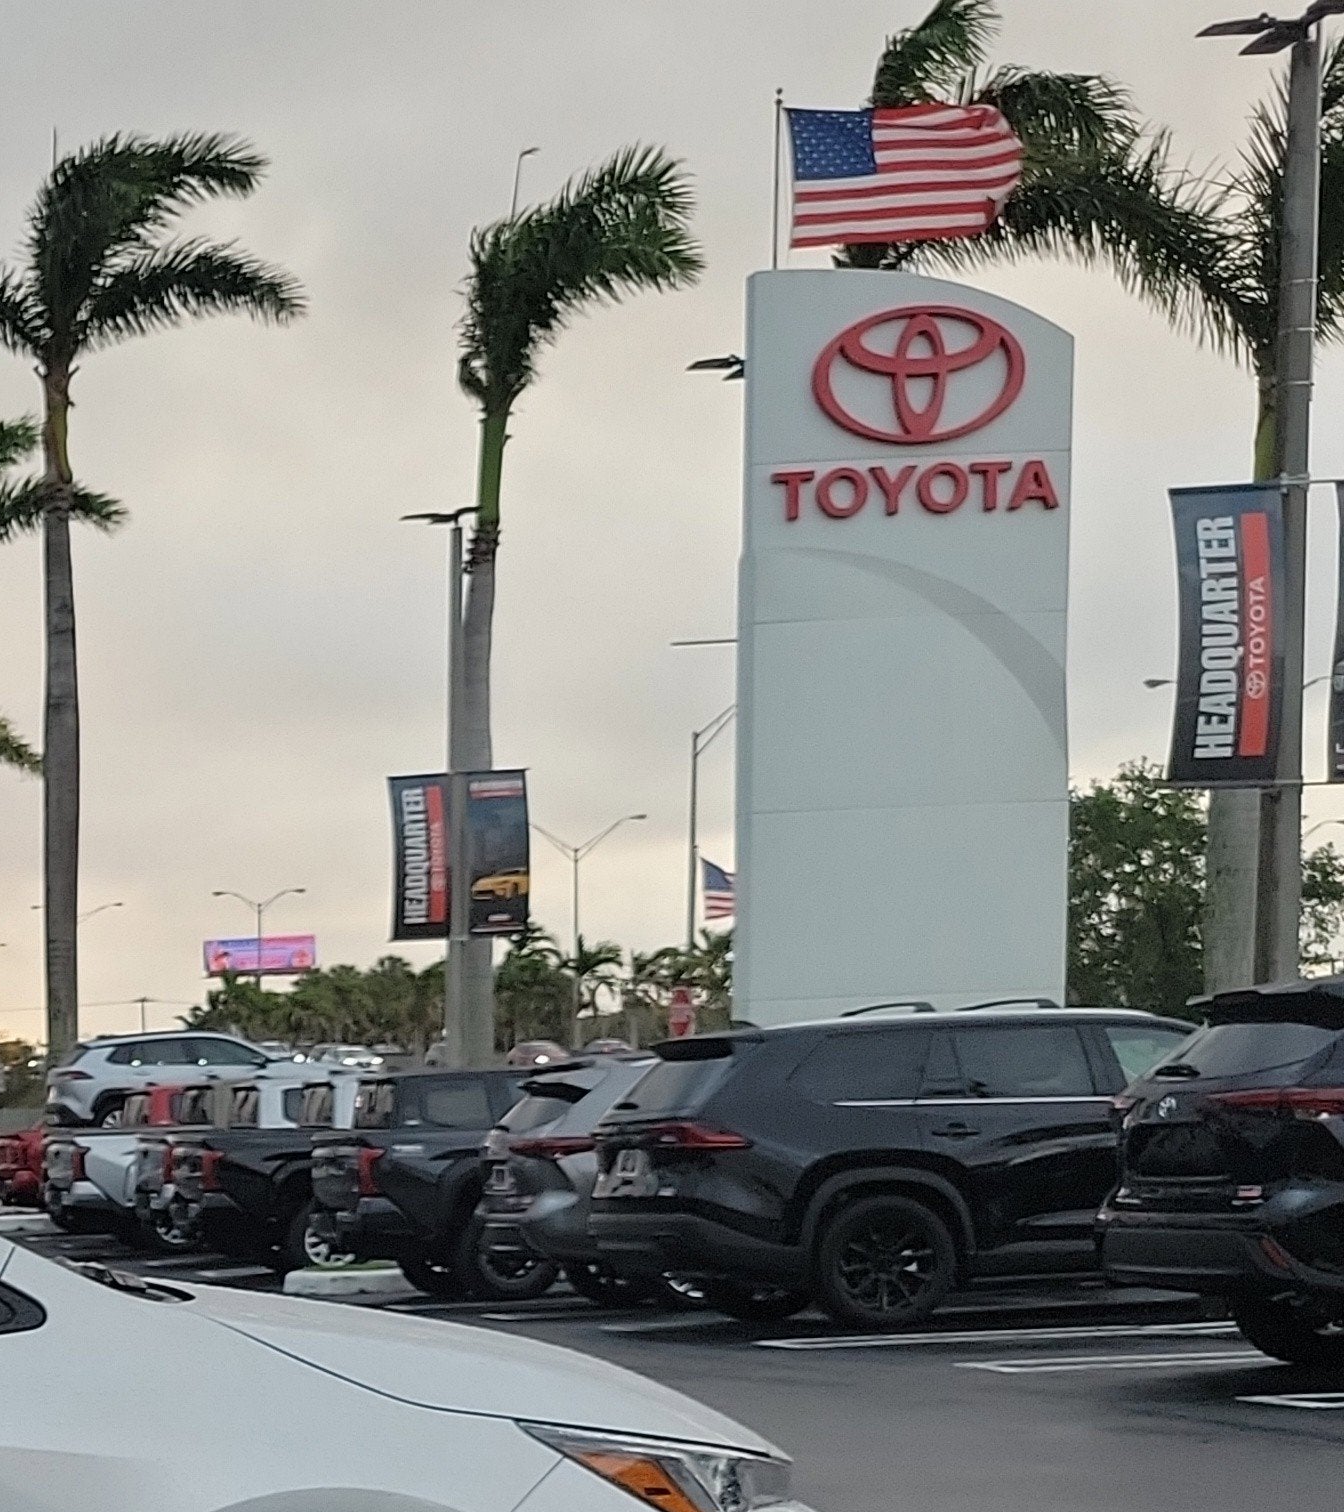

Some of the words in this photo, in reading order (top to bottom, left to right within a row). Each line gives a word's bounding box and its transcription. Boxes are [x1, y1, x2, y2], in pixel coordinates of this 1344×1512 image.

[771, 460, 1059, 522] TOYOTA
[1194, 515, 1243, 759] HEADQUARTER
[1249, 576, 1266, 668] TOYOTA
[402, 787, 429, 925] HEADQUARTER
